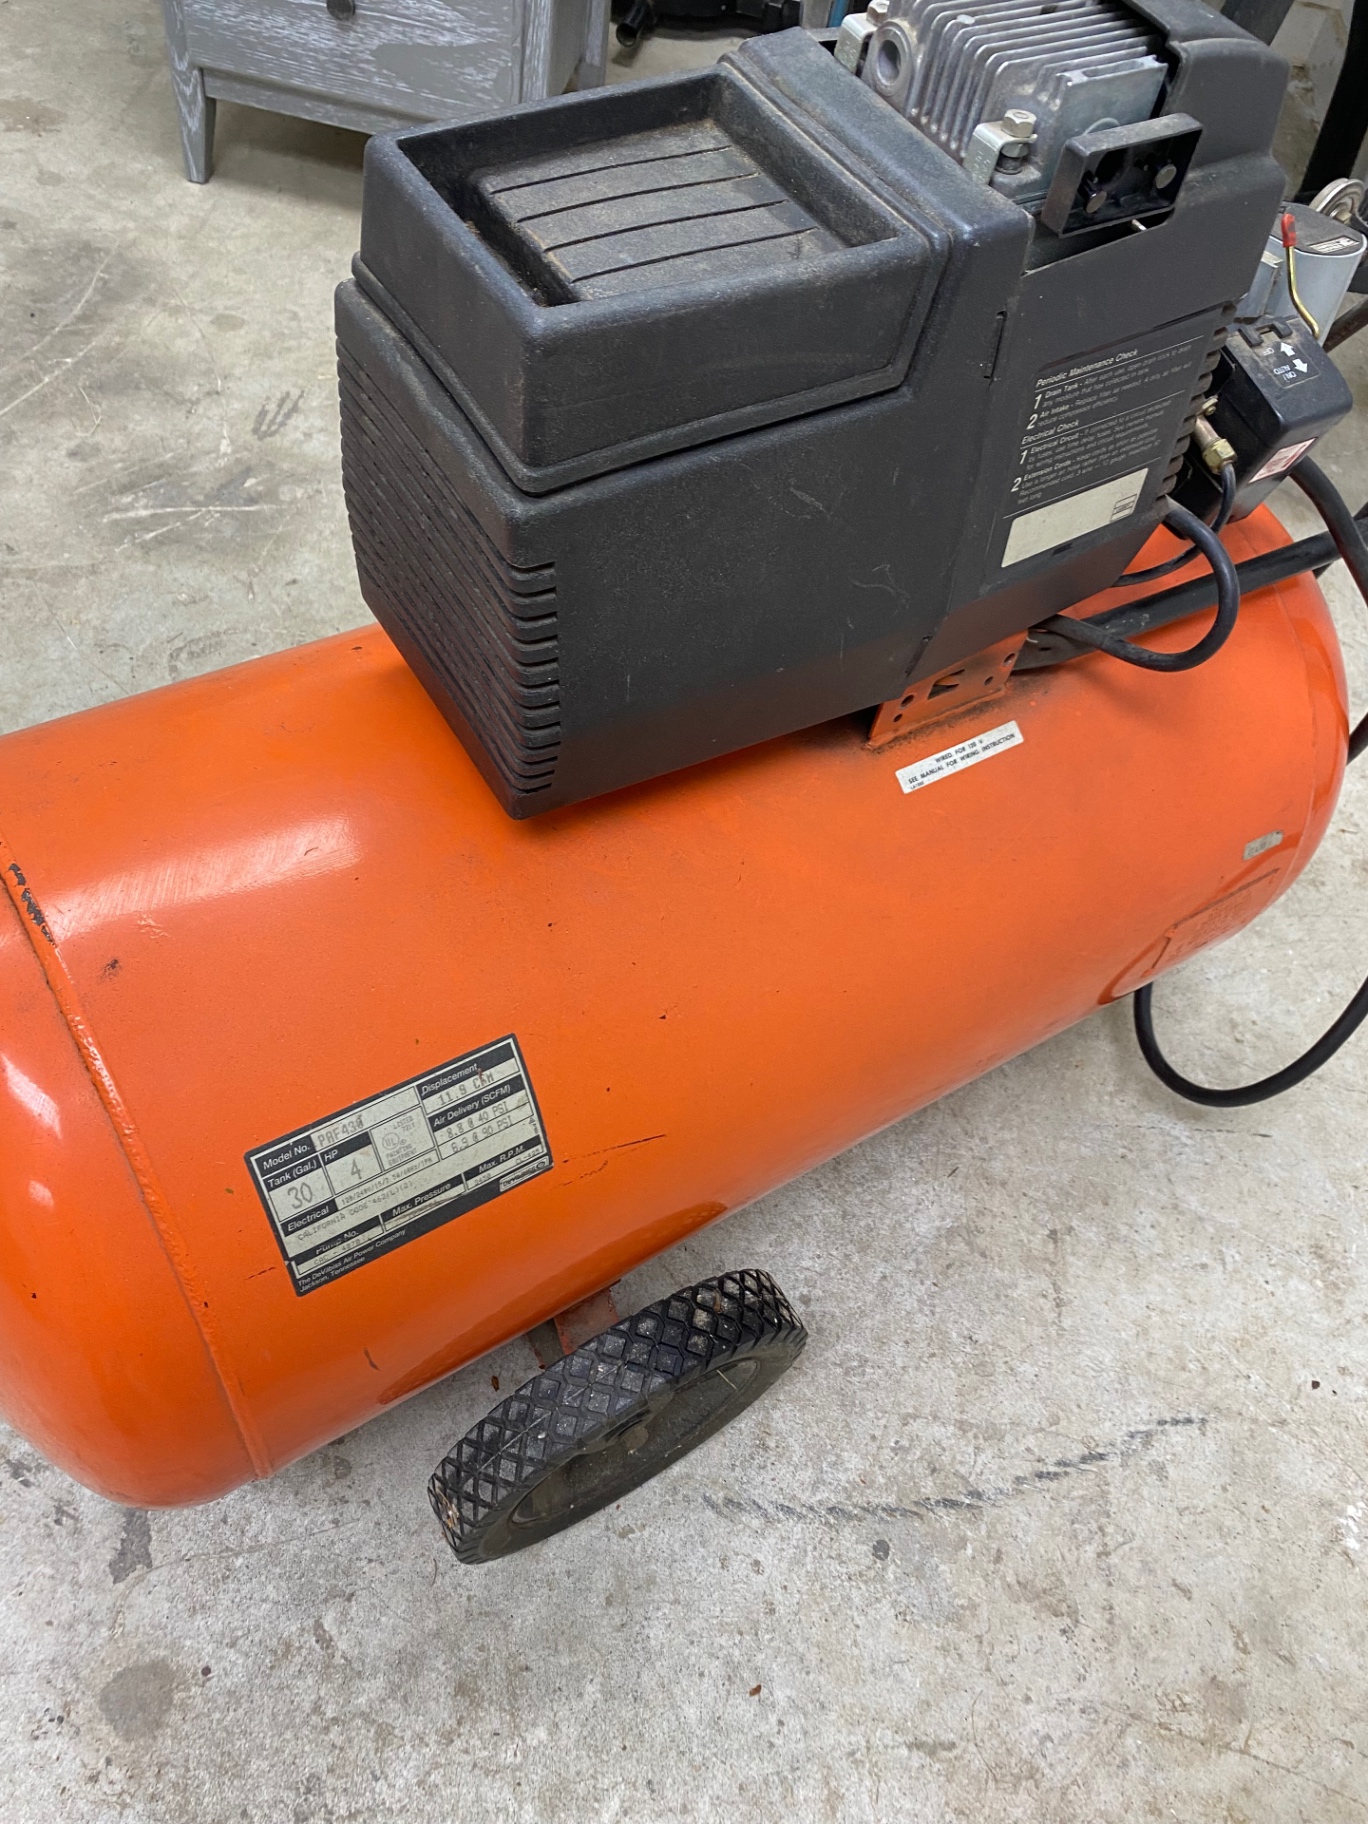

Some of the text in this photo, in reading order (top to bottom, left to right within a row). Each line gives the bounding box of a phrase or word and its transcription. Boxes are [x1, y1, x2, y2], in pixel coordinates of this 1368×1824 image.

[1036, 349, 1138, 387] Periodic Maintenance Check
[1273, 365, 1290, 375] AUTO
[1034, 394, 1042, 409] 1
[1064, 383, 1078, 391] Tank
[1027, 414, 1038, 430] 2
[1051, 405, 1069, 414] Intake
[1022, 419, 1079, 445] Electrical Check
[1020, 450, 1028, 464] 1
[1030, 440, 1058, 454] Electrical
[1011, 477, 1022, 492] 2
[908, 734, 1015, 784] SEE MANUAL FOR WIRING INSTRUCTION
[936, 753, 952, 762] WIRED
[422, 1063, 479, 1096] Displacement
[434, 1084, 510, 1127] Air Delivery (SCFM)
[438, 1084, 467, 1105] 11.9
[446, 1122, 466, 1139] 8.8
[478, 1111, 489, 1122] 40
[492, 1101, 509, 1116] PSI
[451, 1137, 472, 1155] 6.9
[483, 1126, 495, 1139] 90
[497, 1115, 514, 1132] PSI
[263, 1145, 310, 1170] Model No.
[324, 1149, 338, 1162] HP
[479, 1160, 498, 1173] Max.
[267, 1159, 317, 1187] Tank (Gal.)
[349, 1159, 362, 1180] 4
[287, 1182, 314, 1209] 30
[392, 1203, 412, 1216] Max.
[414, 1183, 451, 1205] Pressure
[288, 1206, 329, 1231] Electrical
[297, 1213, 345, 1241] CALIFORNIA
[375, 1229, 406, 1247] Company
